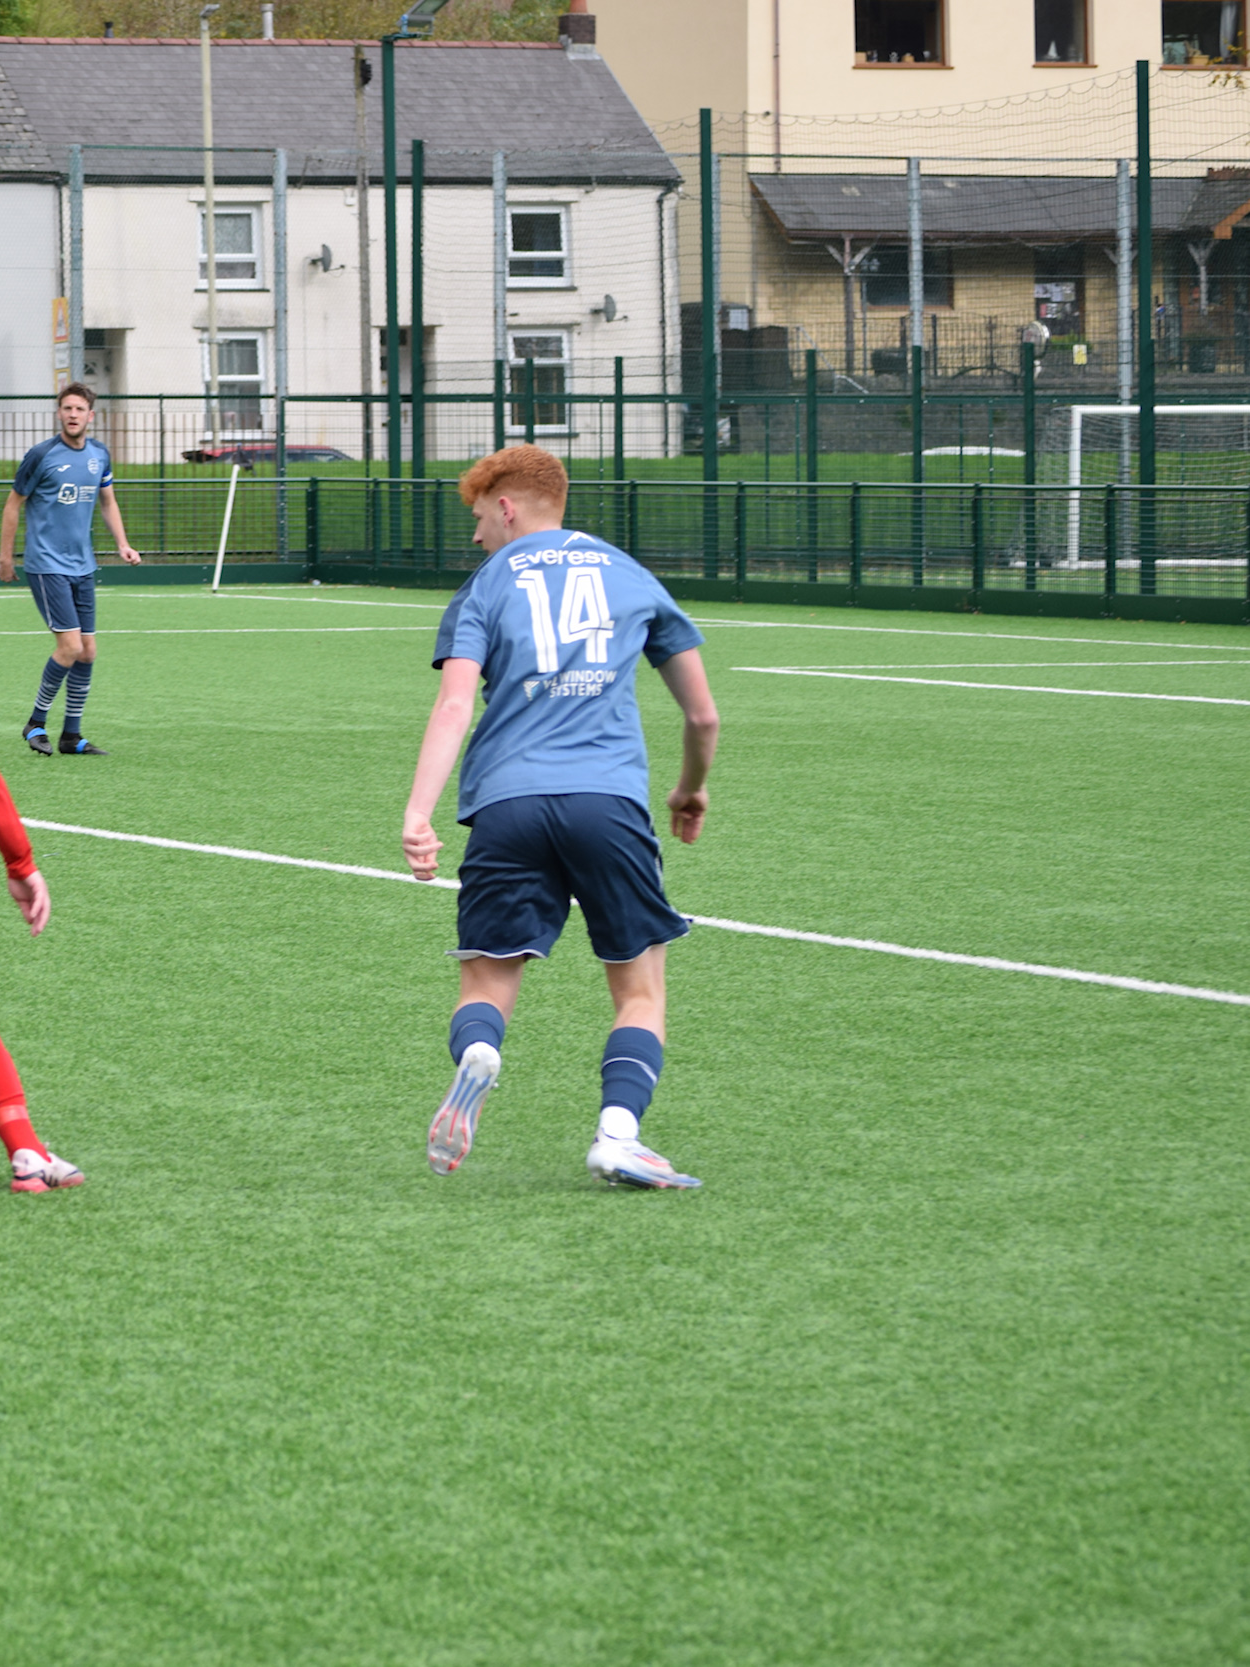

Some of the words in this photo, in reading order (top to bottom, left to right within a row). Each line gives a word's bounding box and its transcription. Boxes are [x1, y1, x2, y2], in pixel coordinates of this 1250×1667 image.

[508, 549, 612, 571] Everest
[515, 567, 615, 673] 14
[559, 670, 617, 684] WINDOW
[550, 683, 603, 698] SYSTEMS
